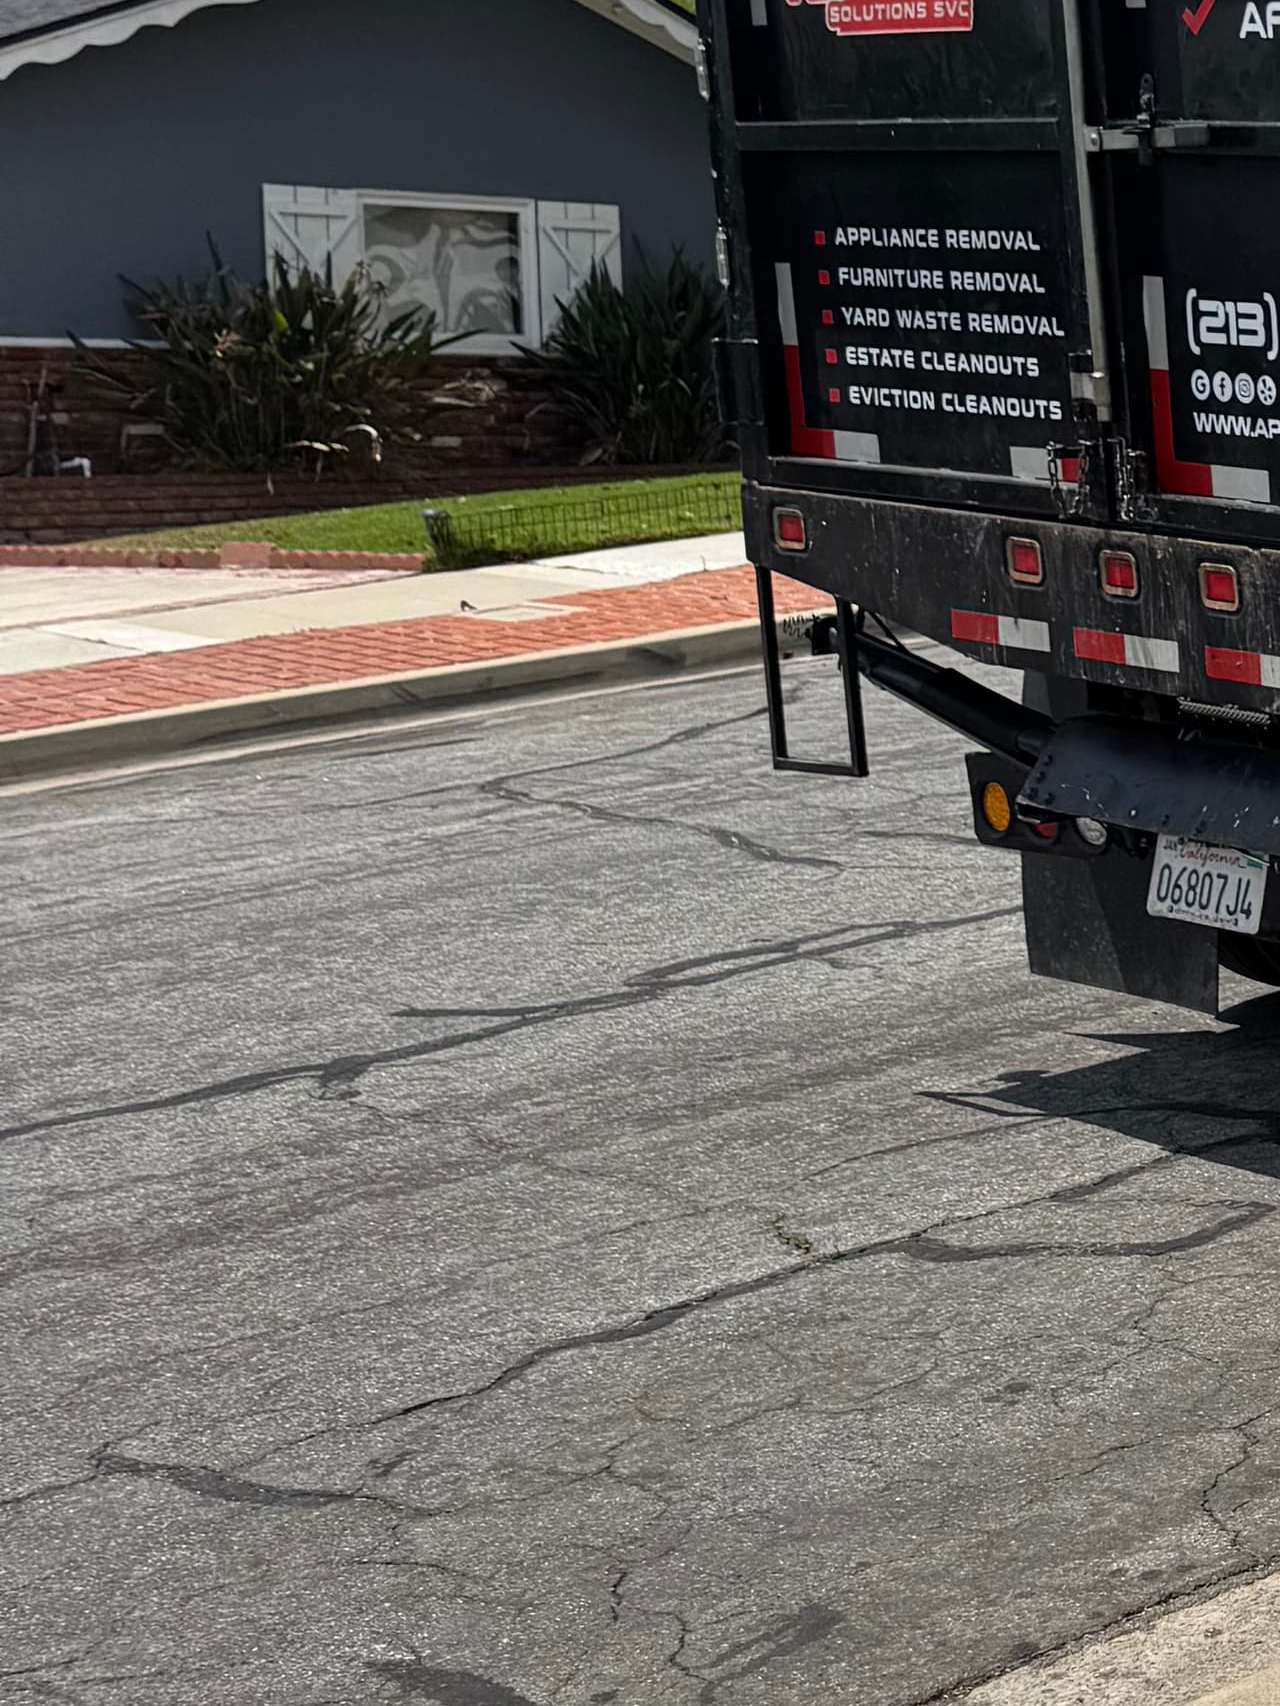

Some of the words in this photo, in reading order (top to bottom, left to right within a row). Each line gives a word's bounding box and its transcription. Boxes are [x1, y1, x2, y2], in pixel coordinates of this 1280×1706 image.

[828, 1, 928, 23] SOLUTIONS
[932, 0, 970, 19] SVC
[834, 226, 940, 249] APPLIANCE
[945, 229, 1041, 252] REMOVAL
[837, 266, 945, 290] FURNITURE
[950, 270, 1046, 294] REMOVAL
[841, 306, 890, 328] YARD
[895, 308, 963, 332] WASTE
[967, 312, 1066, 337] REMOVAL
[845, 345, 916, 370] ESTATE
[920, 350, 1040, 378] CLEANOUTS
[848, 385, 936, 411] EVICTION
[941, 392, 1063, 421] CLEANOUTS
[1156, 863, 1253, 920] 06807J4
